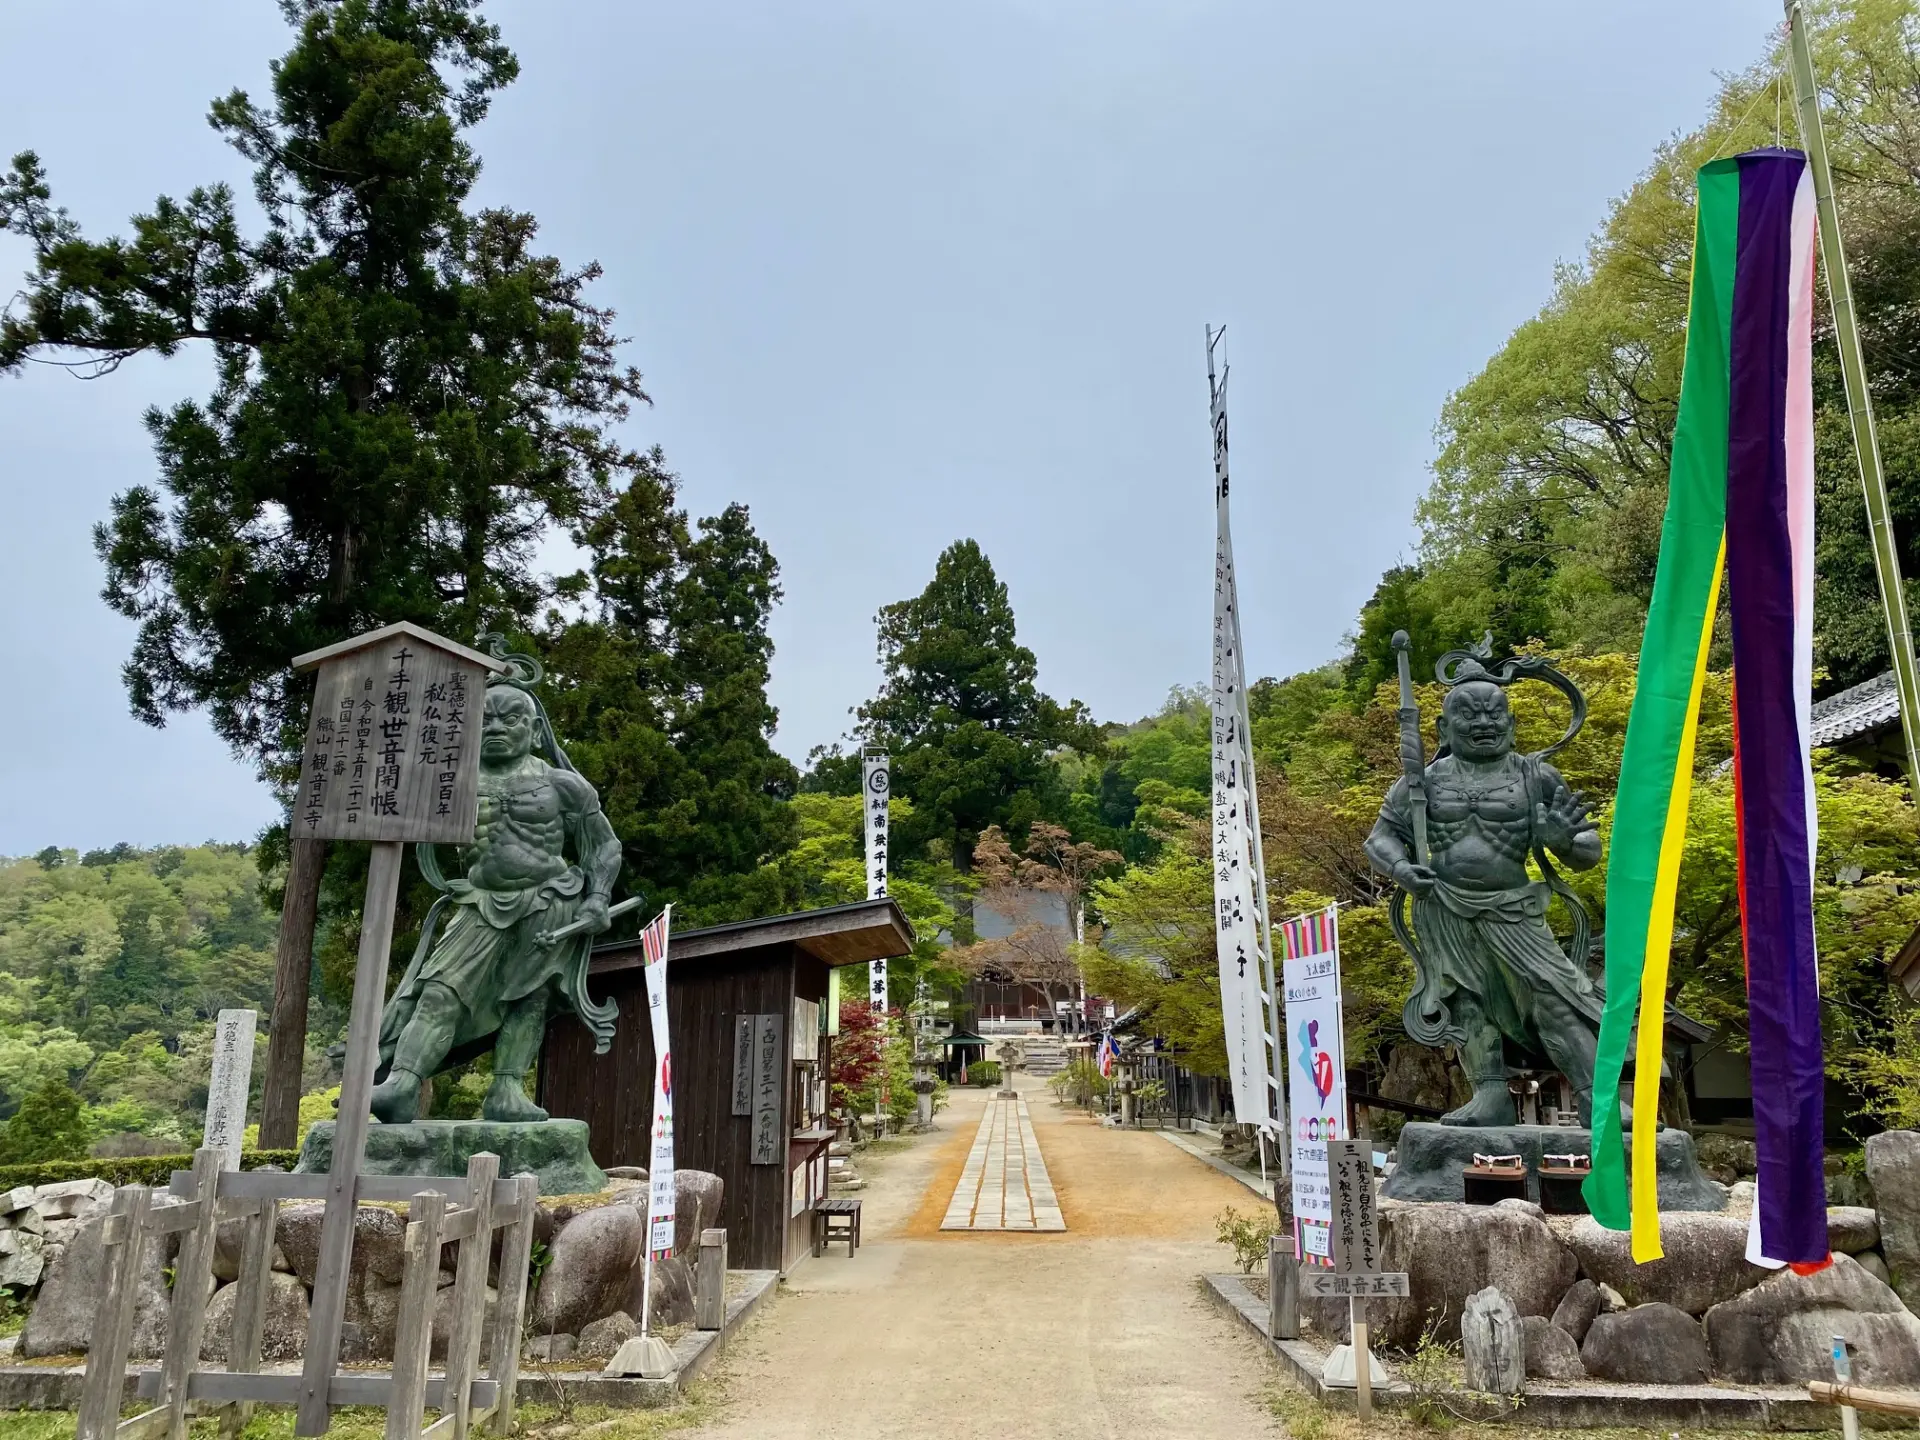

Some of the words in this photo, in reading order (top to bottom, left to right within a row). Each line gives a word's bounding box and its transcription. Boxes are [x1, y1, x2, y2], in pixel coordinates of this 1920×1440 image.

[332, 697, 354, 777] 西国三十二番
[370, 647, 414, 817] 千手観世音開帳
[418, 682, 447, 765] 秘仏復元
[435, 671, 468, 818] 聖徳太子一千四百年
[758, 1028, 776, 1162] 西国第三十二番札所
[1343, 1144, 1361, 1157] 三
[1336, 1160, 1355, 1272] いる祖先の徳に感謝しよう
[1354, 1159, 1375, 1269] 祖先は自分の中に生きて
[1332, 1276, 1406, 1295] 観音正寺
